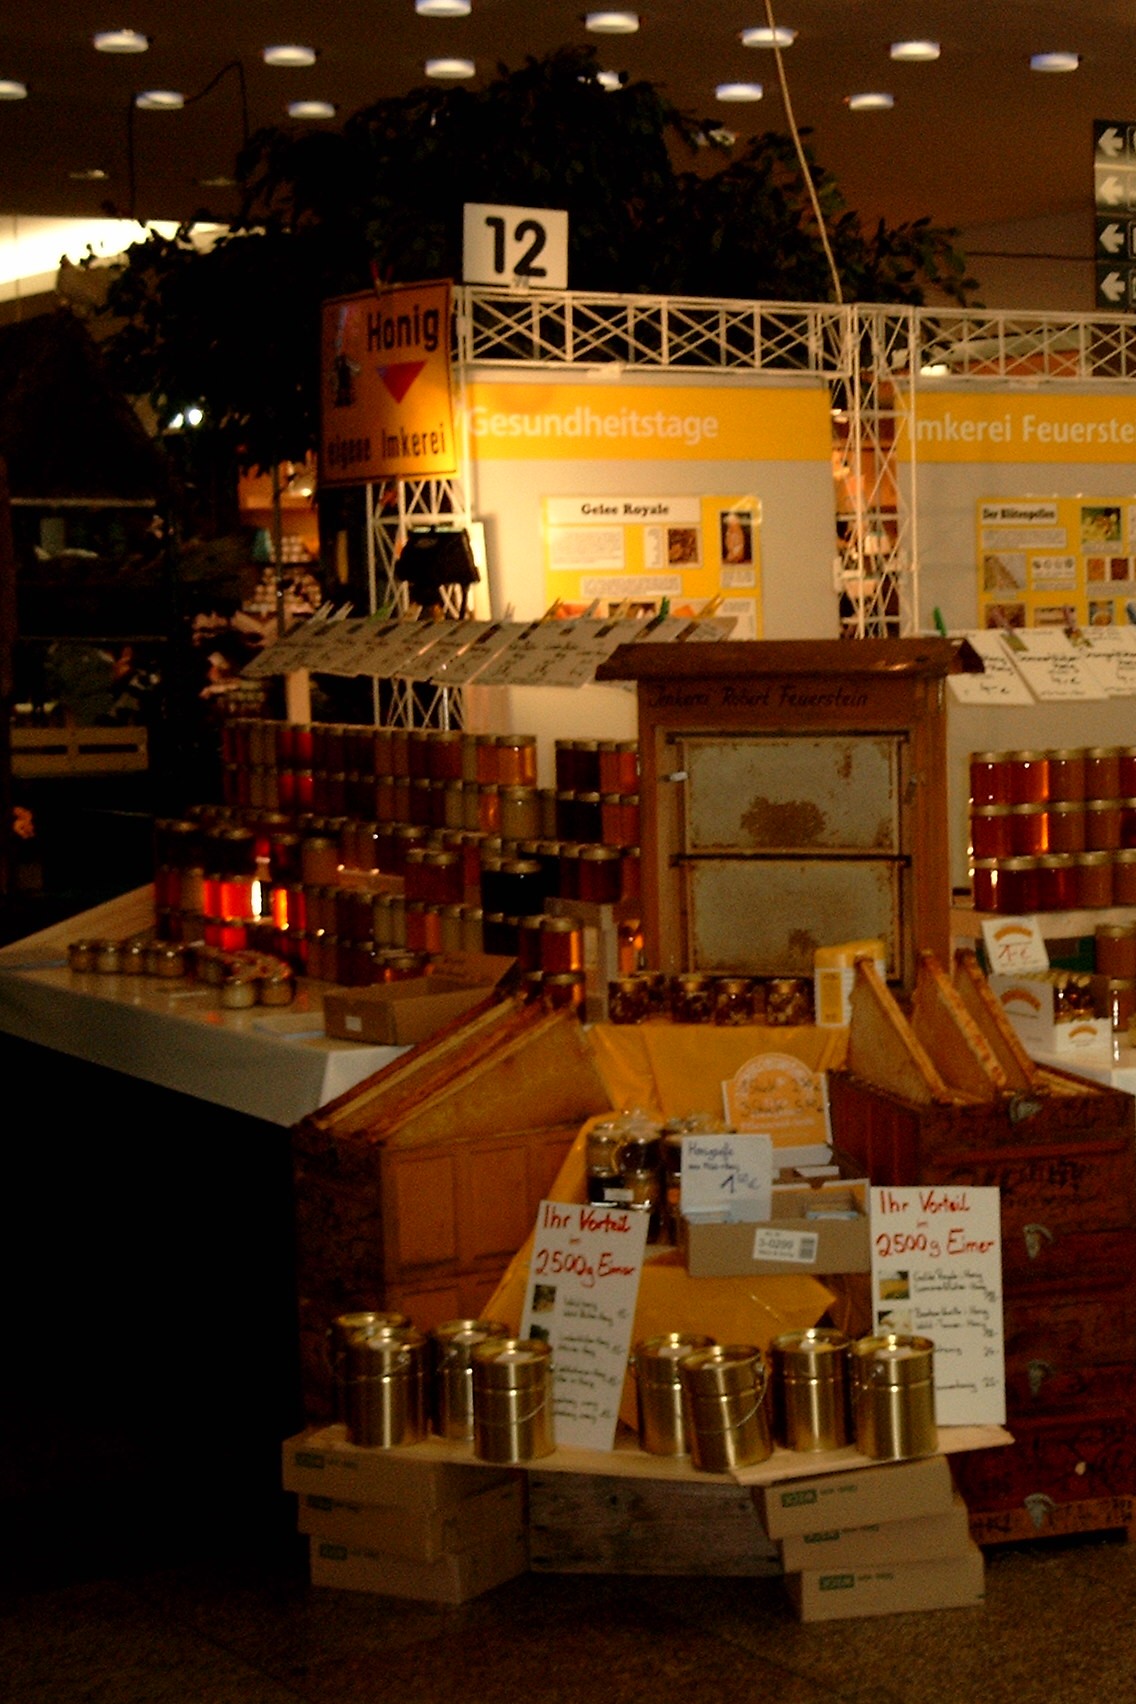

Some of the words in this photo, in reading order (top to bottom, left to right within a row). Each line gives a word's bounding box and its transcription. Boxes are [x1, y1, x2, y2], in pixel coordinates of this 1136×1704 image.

[486, 217, 546, 277] 12
[367, 303, 439, 351] Honig
[382, 422, 446, 458] Imkerei
[469, 404, 719, 446] Gesundheitstage
[581, 504, 619, 516] Gelee
[623, 503, 670, 518] Royale
[778, 684, 869, 707] Feuerstein
[542, 1204, 571, 1230] Ihr
[579, 1209, 632, 1234] Vorteil
[880, 1190, 910, 1215] Ihr
[918, 1190, 971, 1214] Vorteil
[875, 1232, 942, 1258] 2500g
[947, 1228, 995, 1255] Eimer
[535, 1249, 595, 1289] 2500g
[597, 1252, 635, 1277] Eimer
